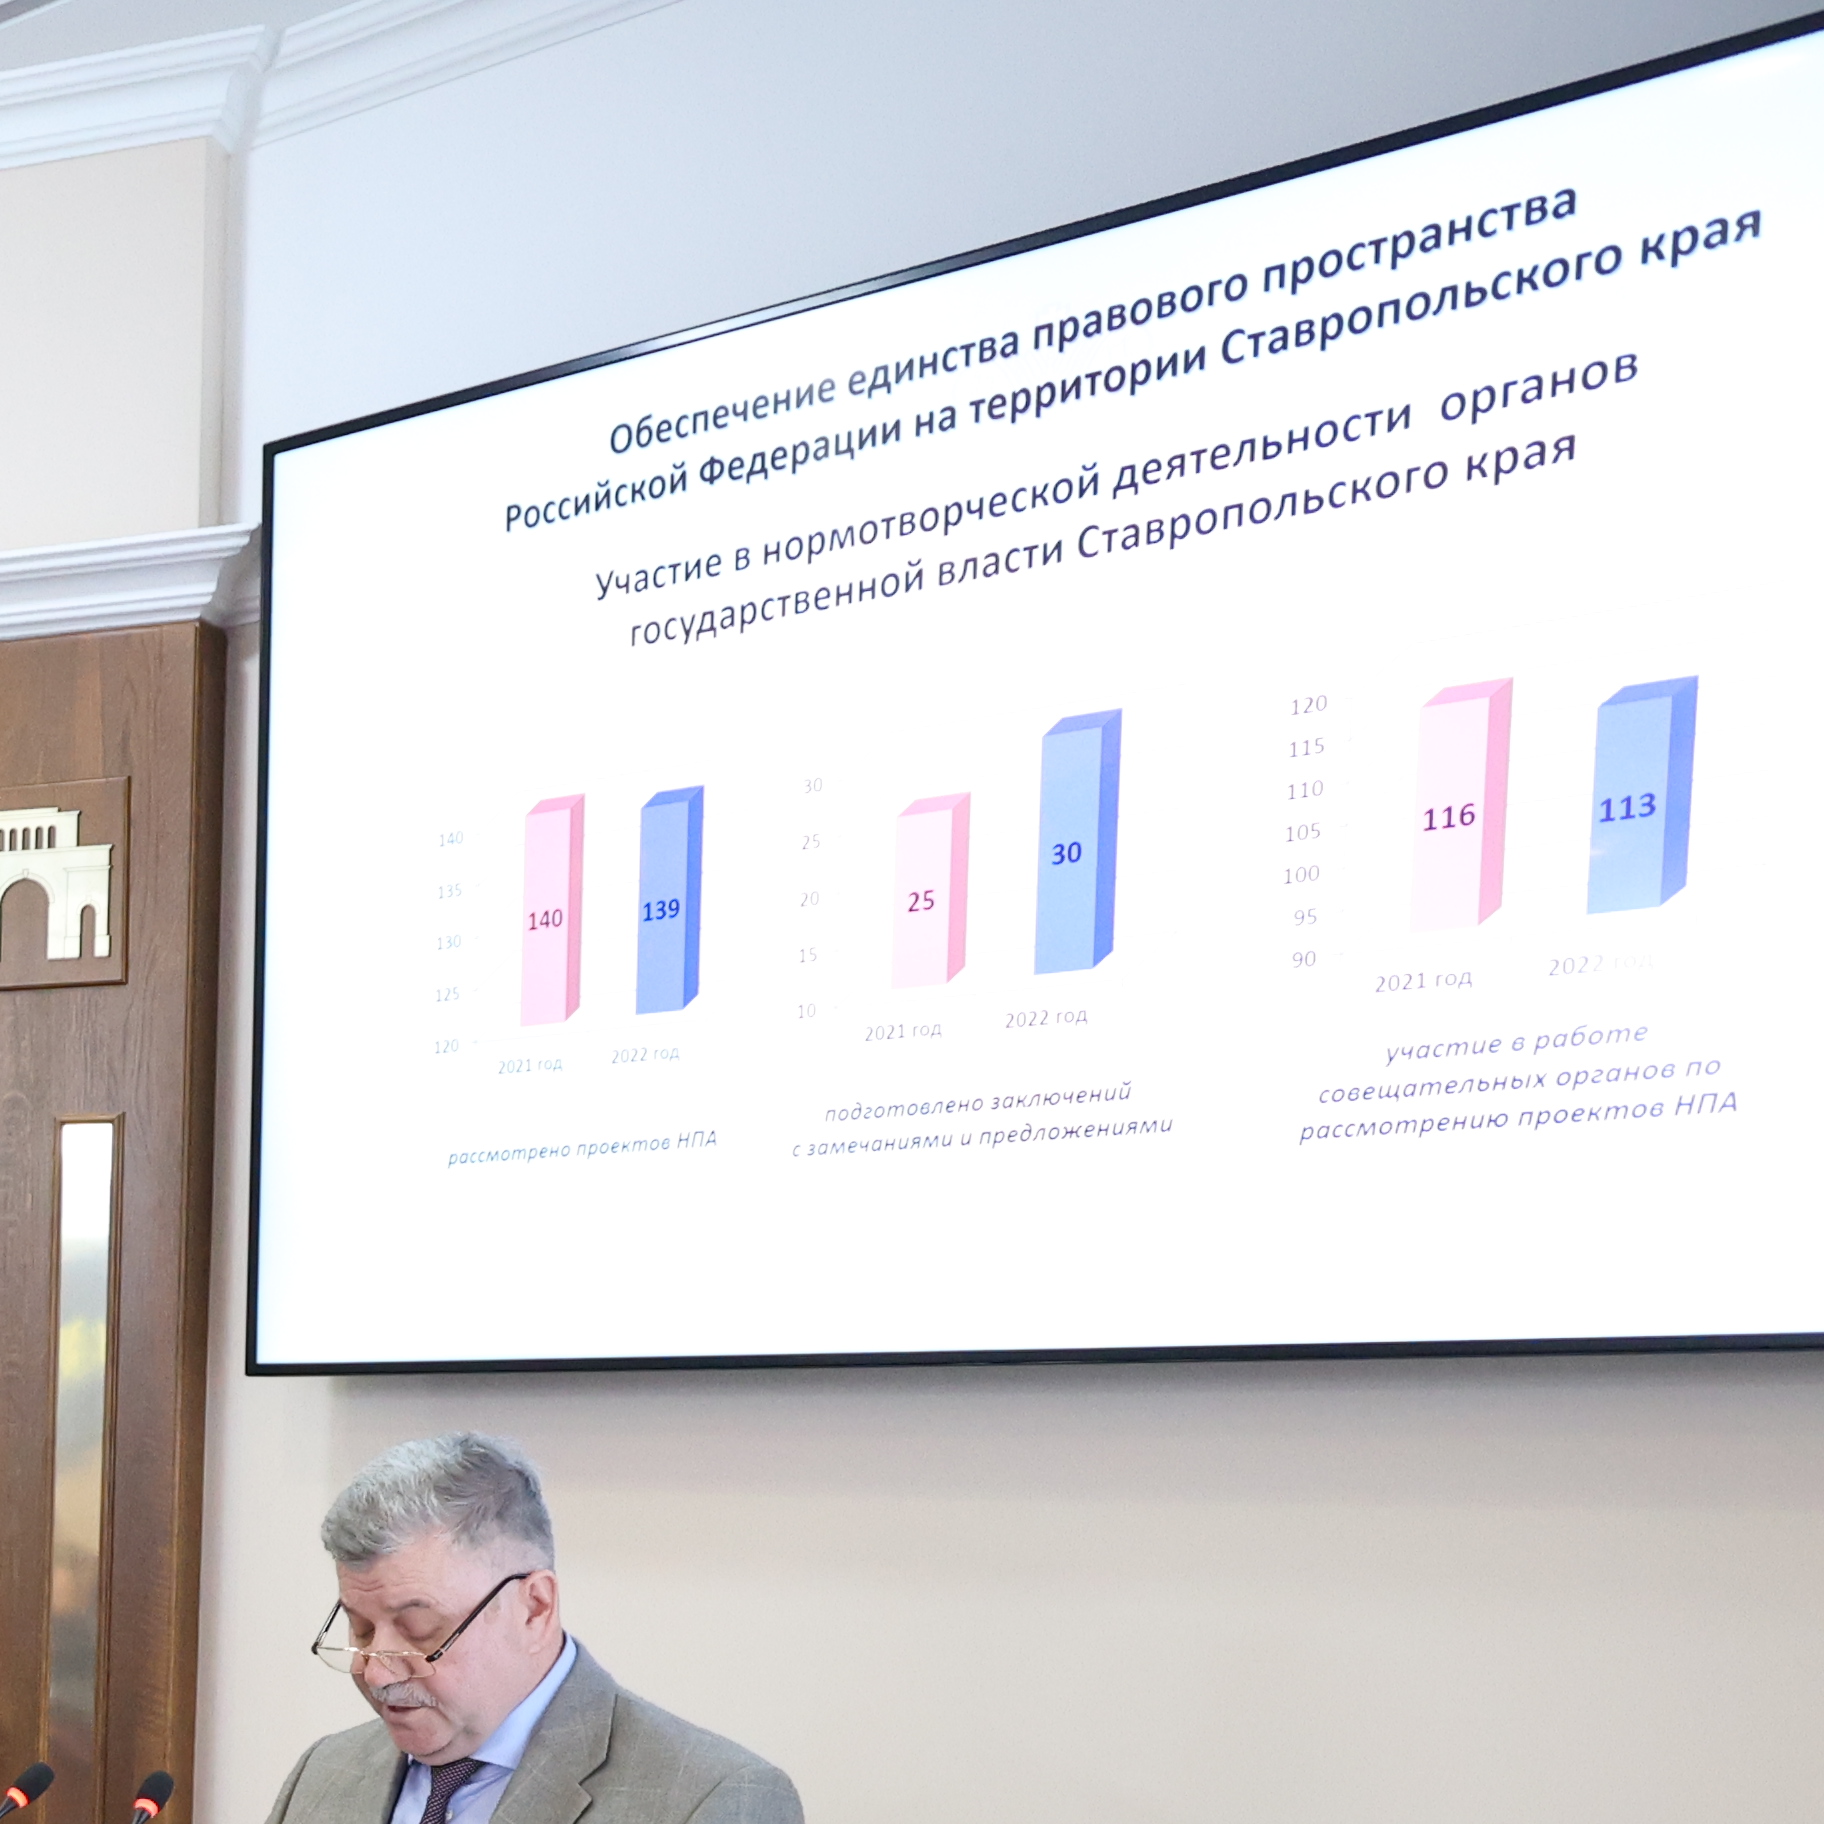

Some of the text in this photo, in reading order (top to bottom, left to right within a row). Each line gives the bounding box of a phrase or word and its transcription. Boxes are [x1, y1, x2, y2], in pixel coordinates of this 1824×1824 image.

[609, 187, 1578, 455] Обеспечение единства правового пространства
[505, 208, 1762, 534] Российской Федерации на территории Ставропольского края
[595, 352, 1639, 602] Участие в нормотворческой деятельности органов
[631, 433, 1576, 647] государственной власти Ставропольского края
[1290, 694, 1328, 716] 120
[1289, 736, 1325, 759] 115
[804, 777, 823, 794] 30
[1287, 779, 1324, 801] 110
[1423, 802, 1476, 832] 116
[1599, 792, 1657, 824] 113
[439, 830, 464, 848] 140
[801, 833, 821, 851] 25
[1285, 821, 1321, 843] 105
[1051, 841, 1082, 866] 30
[1283, 864, 1320, 885] 100
[438, 882, 463, 900] 135
[799, 890, 820, 908] 20
[907, 889, 935, 913] 25
[528, 908, 564, 932] 140
[642, 897, 681, 923] 139
[1293, 907, 1318, 927] 95
[437, 934, 462, 951] 130
[799, 946, 818, 964] 15
[1291, 949, 1317, 969] 90
[1547, 954, 1604, 977] 2022
[1374, 971, 1473, 994] 2021 год
[435, 985, 460, 1003] 125
[797, 1002, 817, 1020] 10
[1004, 1009, 1089, 1029] 2022 год
[864, 1023, 943, 1042] 2021 год
[434, 1038, 460, 1055] 120
[611, 1046, 681, 1065] 2022 год
[1384, 1024, 1649, 1068] участие в работе
[497, 1058, 564, 1075] 2021 год
[1318, 1059, 1722, 1104] совещательных органов по
[825, 1079, 1132, 1123] подготовлено заключений
[1298, 1090, 1738, 1147] рассмотрению проектов НПА
[792, 1118, 1174, 1158] с замечаниями и предложениями
[447, 1129, 718, 1170] рассмотрено проектов НПА
